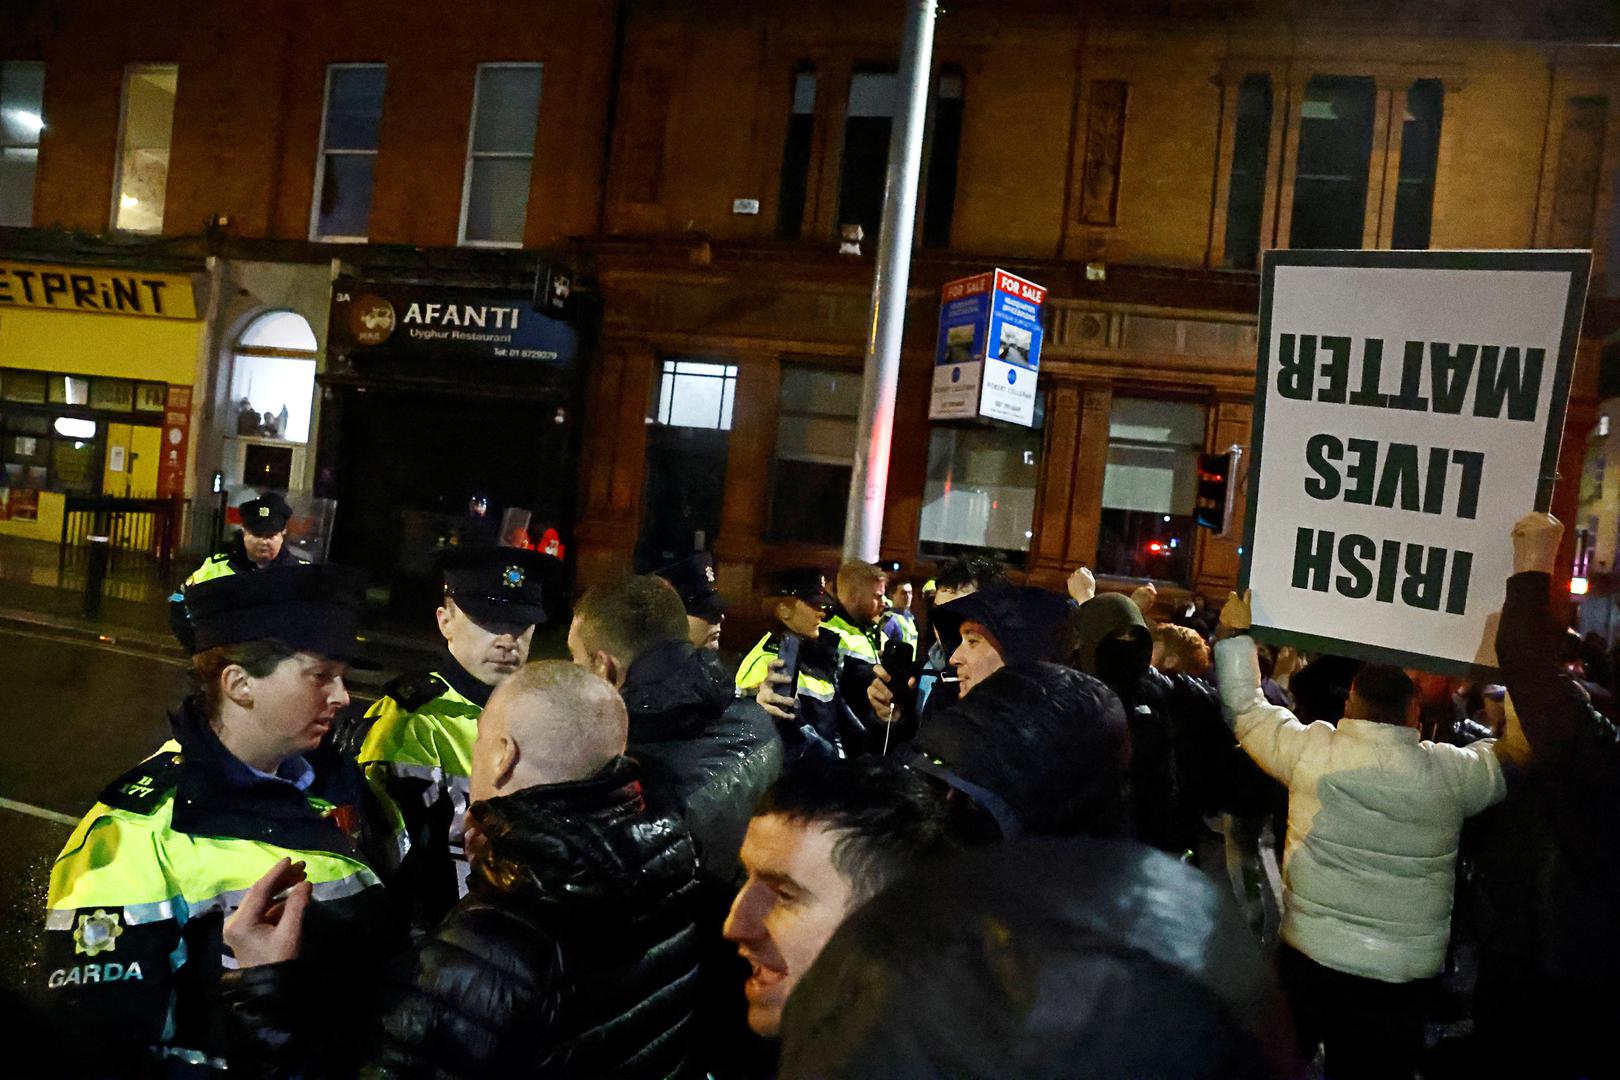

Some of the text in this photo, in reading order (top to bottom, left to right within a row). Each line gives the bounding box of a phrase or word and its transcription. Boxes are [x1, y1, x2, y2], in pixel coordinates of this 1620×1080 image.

[948, 279, 985, 297] FOR SALE
[1001, 276, 1042, 304] FOR SALE
[403, 303, 519, 329] AFANTI
[410, 328, 512, 343] Uyghur Restaurant
[1277, 333, 1546, 422] MATTER
[1304, 434, 1485, 519] LIVES
[1291, 527, 1473, 615] IRISH
[48, 961, 143, 989] GARDA
